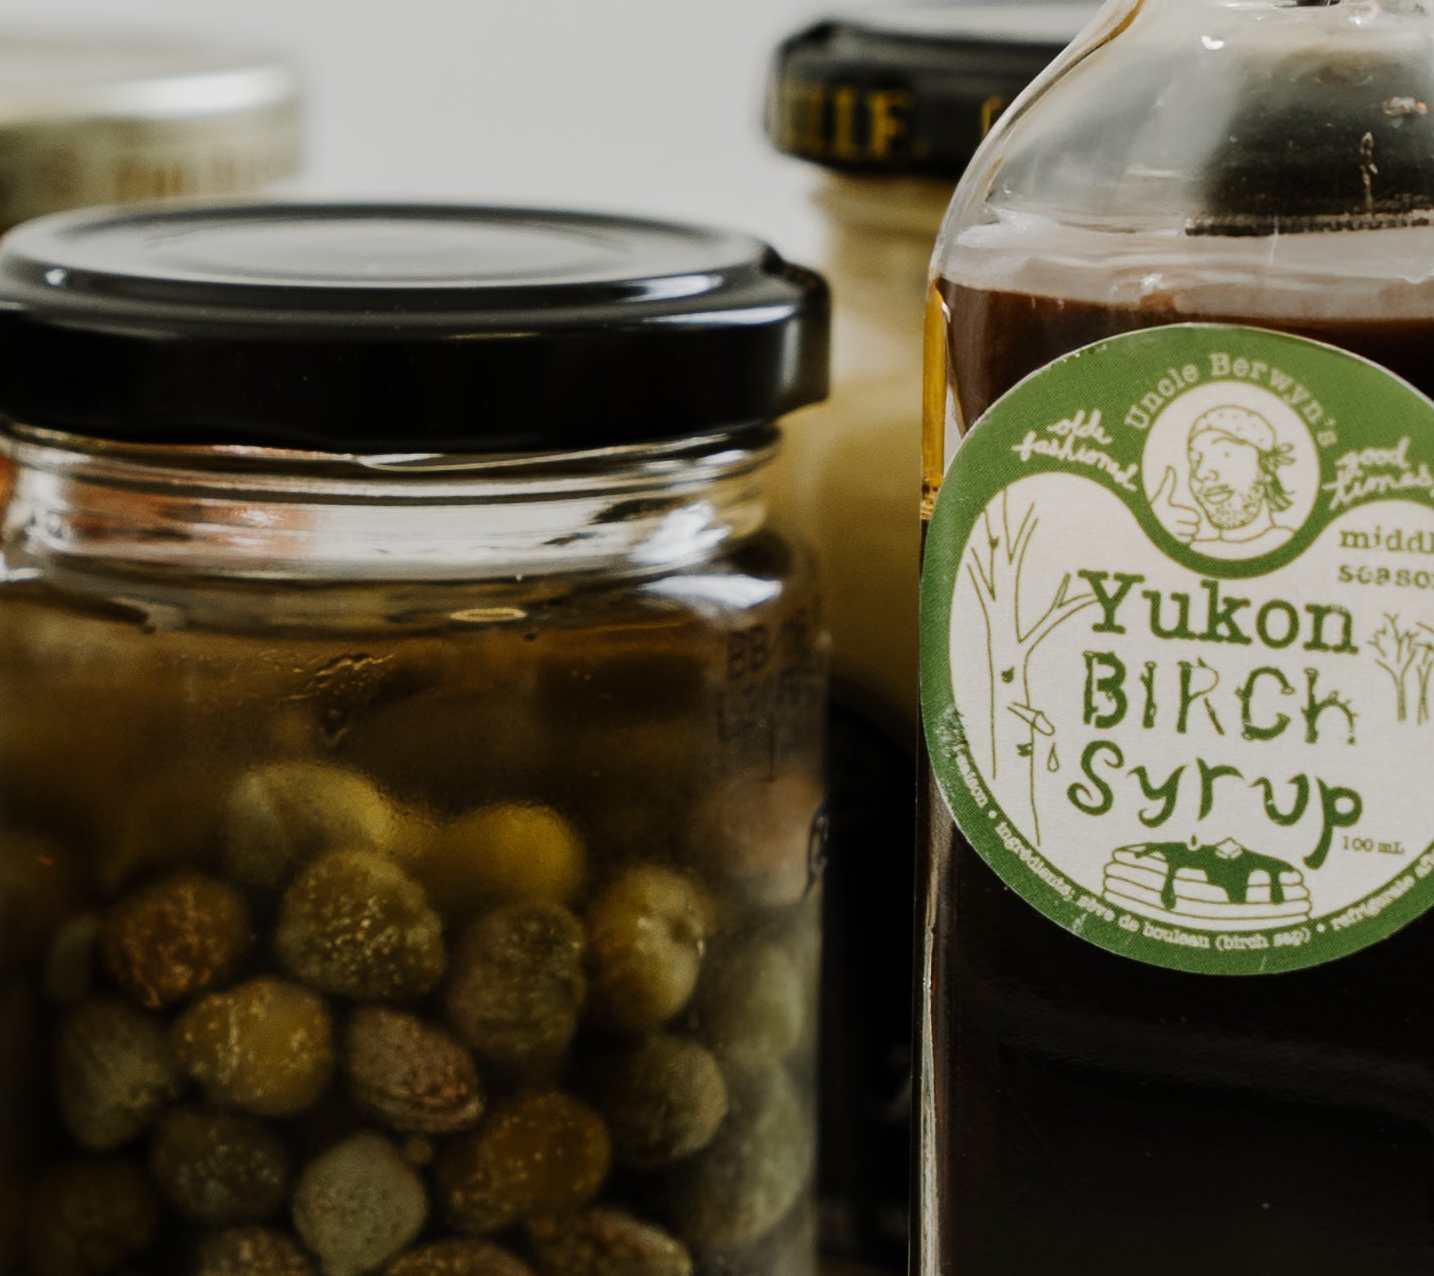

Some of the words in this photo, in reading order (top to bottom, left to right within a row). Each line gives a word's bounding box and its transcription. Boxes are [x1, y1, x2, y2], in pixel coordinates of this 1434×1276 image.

[1125, 364, 1200, 430] Uncle
[1209, 352, 1339, 447] Berwyn's
[1077, 570, 1359, 655] Yukon
[1066, 739, 1363, 870] Syrup
[1342, 835, 1374, 853] 100
